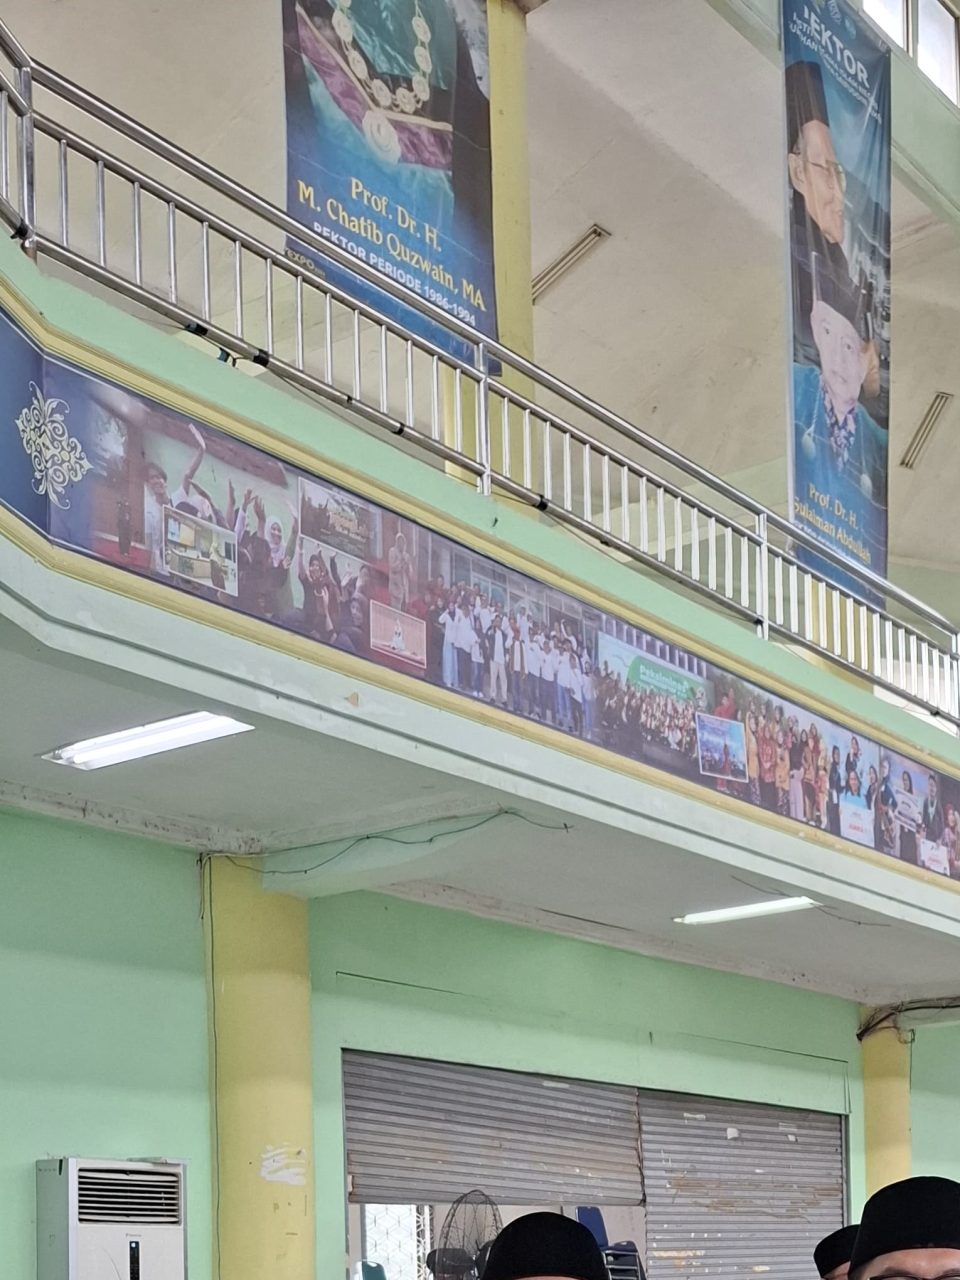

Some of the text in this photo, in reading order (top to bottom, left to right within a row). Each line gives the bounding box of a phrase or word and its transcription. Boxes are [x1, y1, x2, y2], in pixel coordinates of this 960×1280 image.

[298, 180, 487, 312] M. Chatib Quzwain, MA
[351, 177, 442, 251] Prof. Dr. H.
[313, 221, 476, 327] REKTOR PERIODE 1986-1994
[809, 483, 859, 530] Prof. Dr. H.
